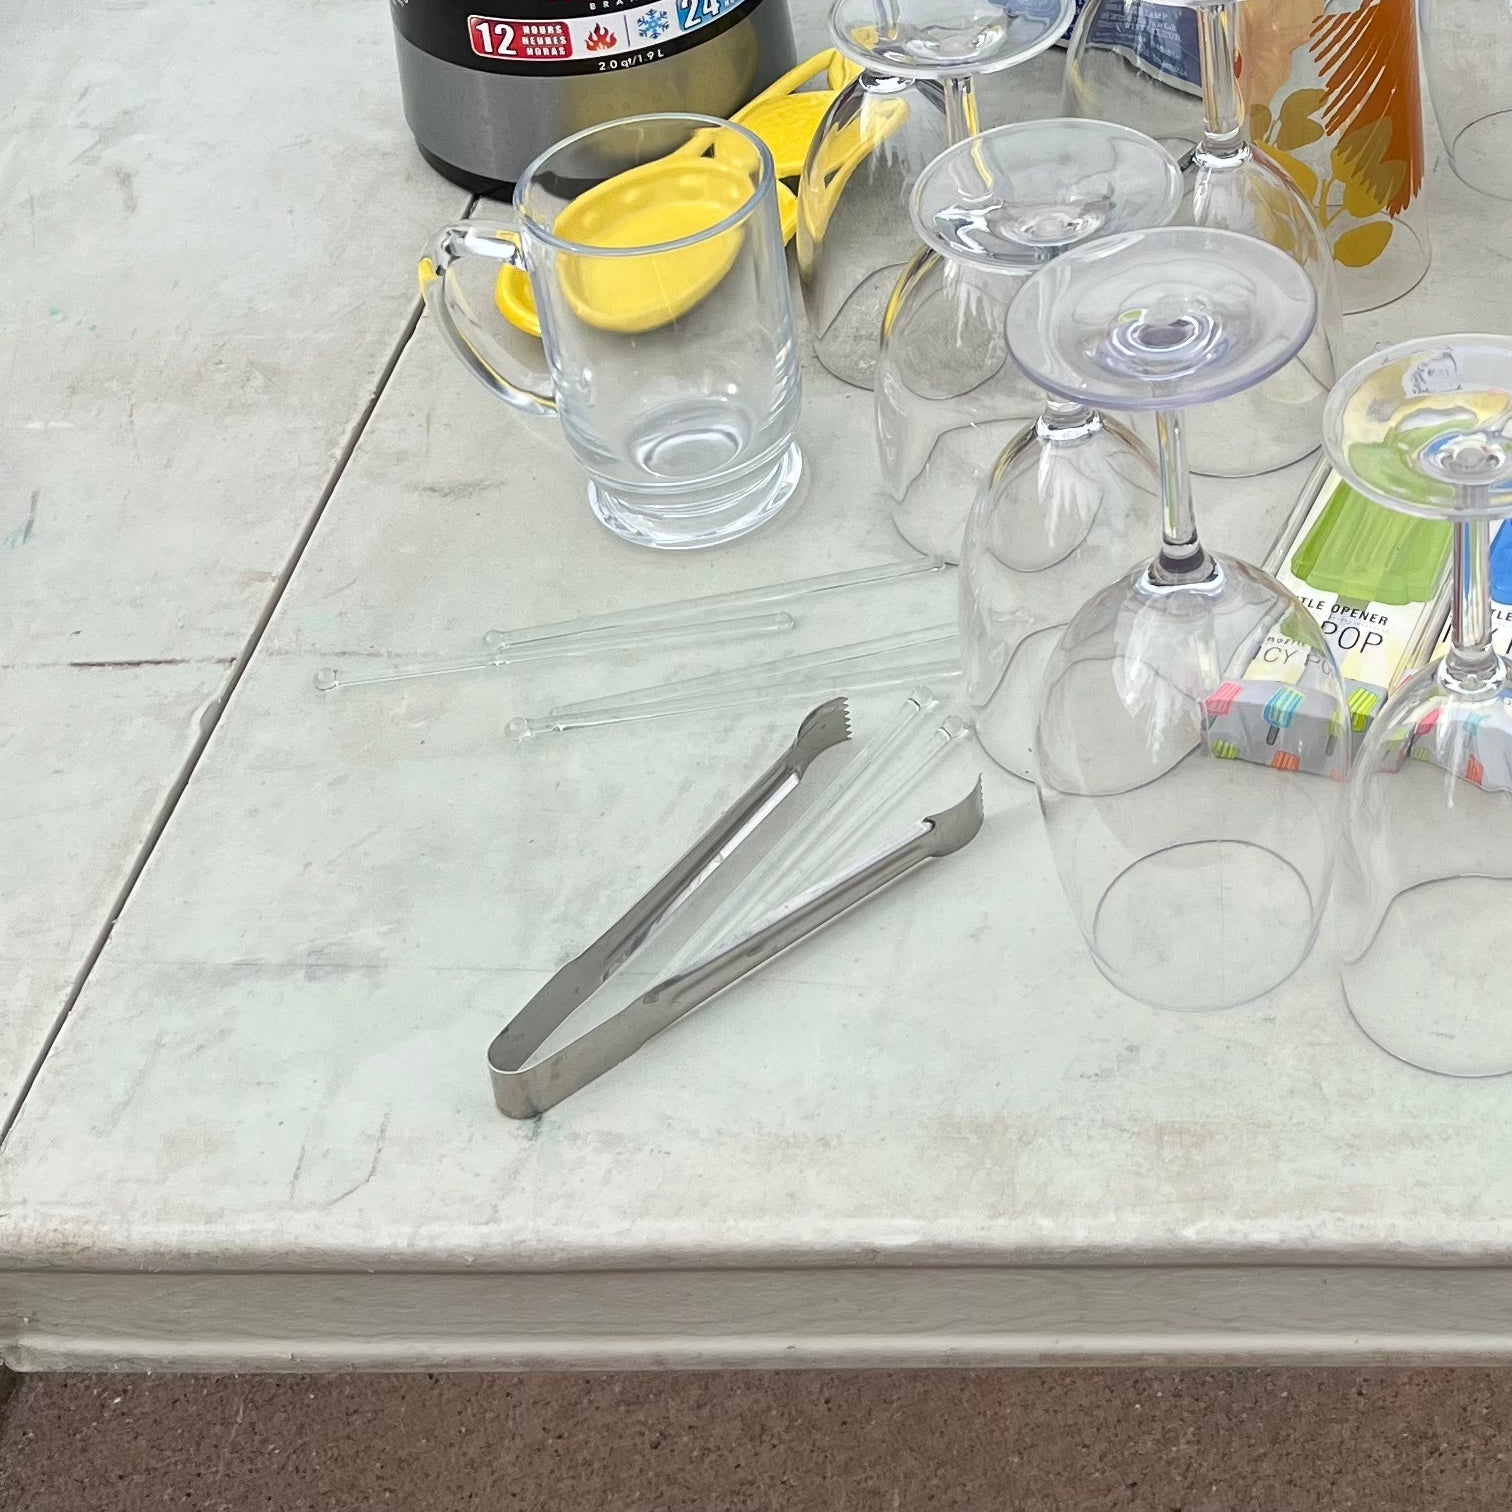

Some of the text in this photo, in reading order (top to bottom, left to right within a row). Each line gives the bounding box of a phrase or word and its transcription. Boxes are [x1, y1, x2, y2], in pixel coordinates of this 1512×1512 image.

[522, 25, 563, 35] HOURS
[475, 22, 517, 56] 12
[521, 36, 568, 46] HEURES
[526, 46, 566, 56] HORAS
[1330, 603, 1389, 626] OPENER
